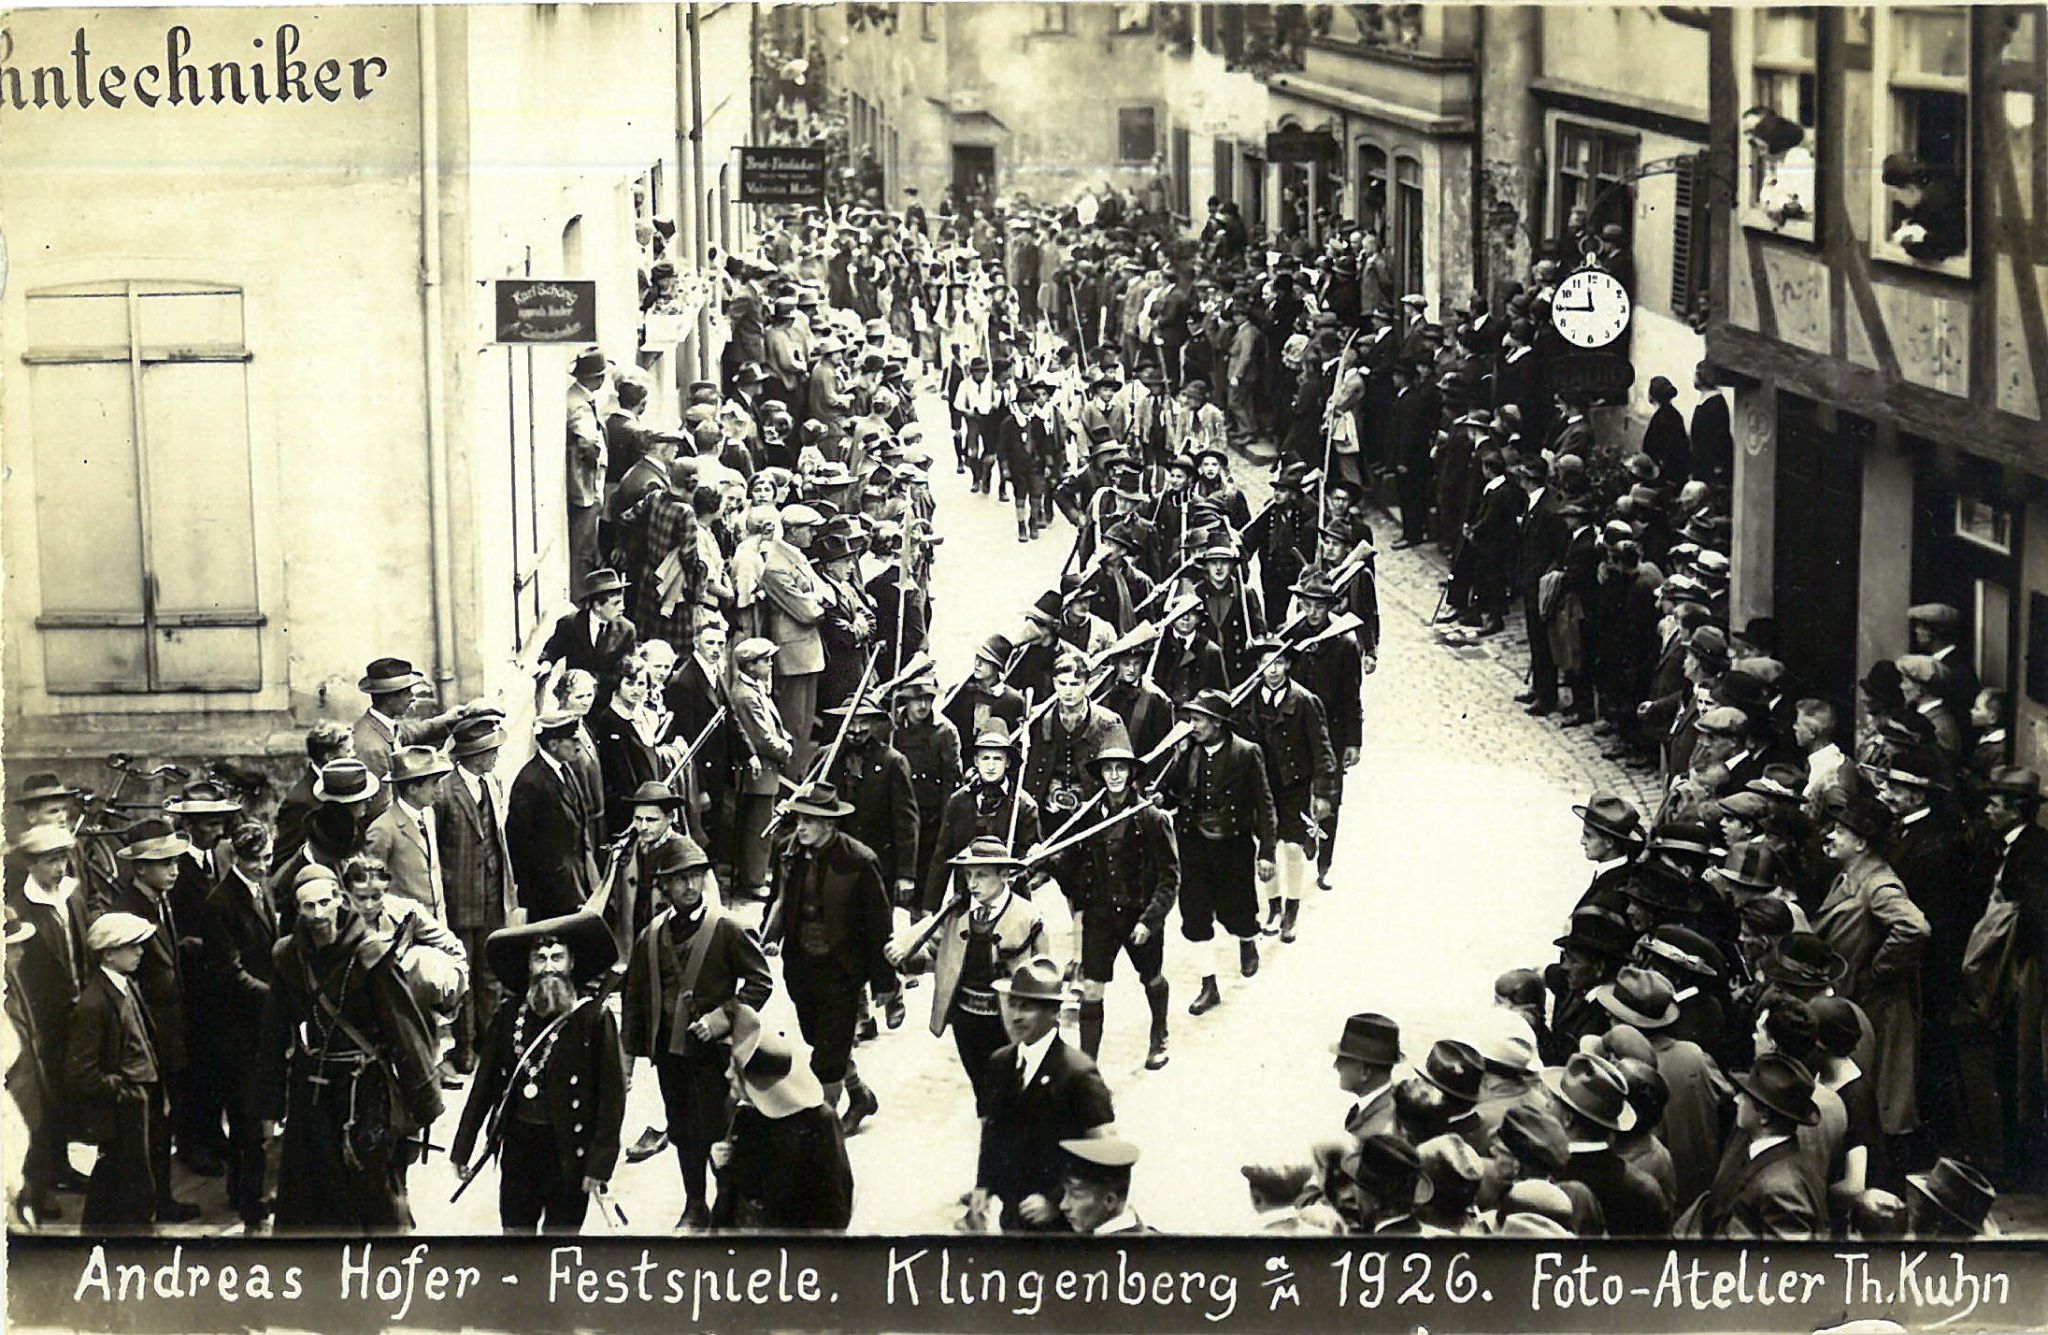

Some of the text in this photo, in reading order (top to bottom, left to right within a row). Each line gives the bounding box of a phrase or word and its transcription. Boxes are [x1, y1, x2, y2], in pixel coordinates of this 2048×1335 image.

[1573, 279, 1581, 288] 11
[1562, 290, 1572, 298] 10
[1616, 290, 1622, 299] 2
[1620, 305, 1626, 314] 3
[1560, 318, 1567, 327] 8
[1571, 330, 1576, 339] 7
[1605, 330, 1610, 339] 5
[1587, 335, 1594, 344] 6
